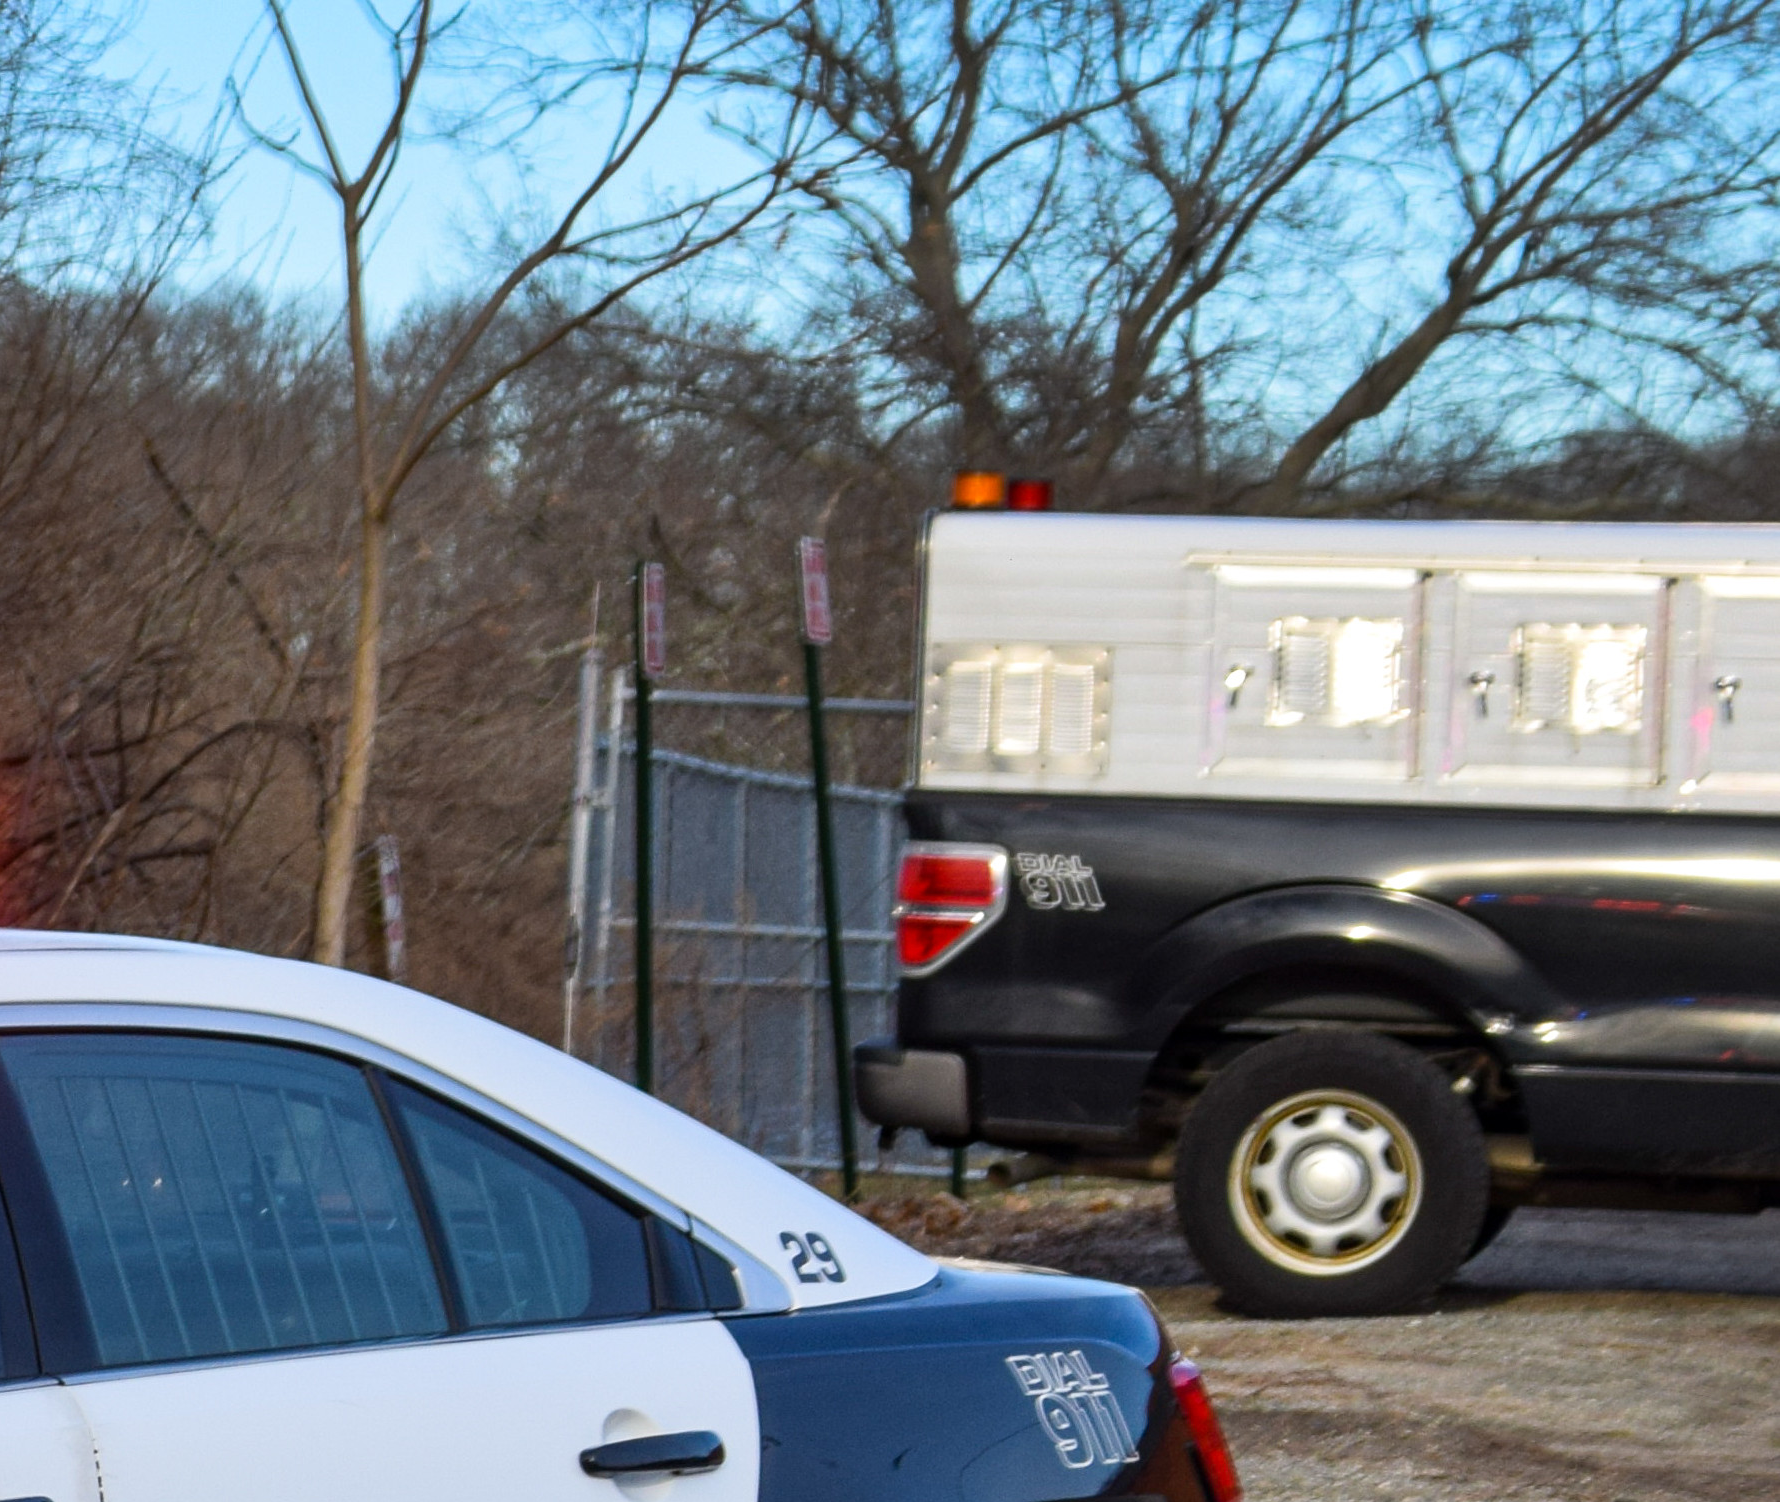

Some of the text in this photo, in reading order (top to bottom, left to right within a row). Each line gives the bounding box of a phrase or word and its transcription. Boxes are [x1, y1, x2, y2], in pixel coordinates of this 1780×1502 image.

[1016, 852, 1093, 877] DIAL
[1024, 869, 1106, 909] 911
[779, 1231, 847, 1283] 29
[1005, 1350, 1110, 1396] DIAL
[1035, 1391, 1140, 1469] 911
